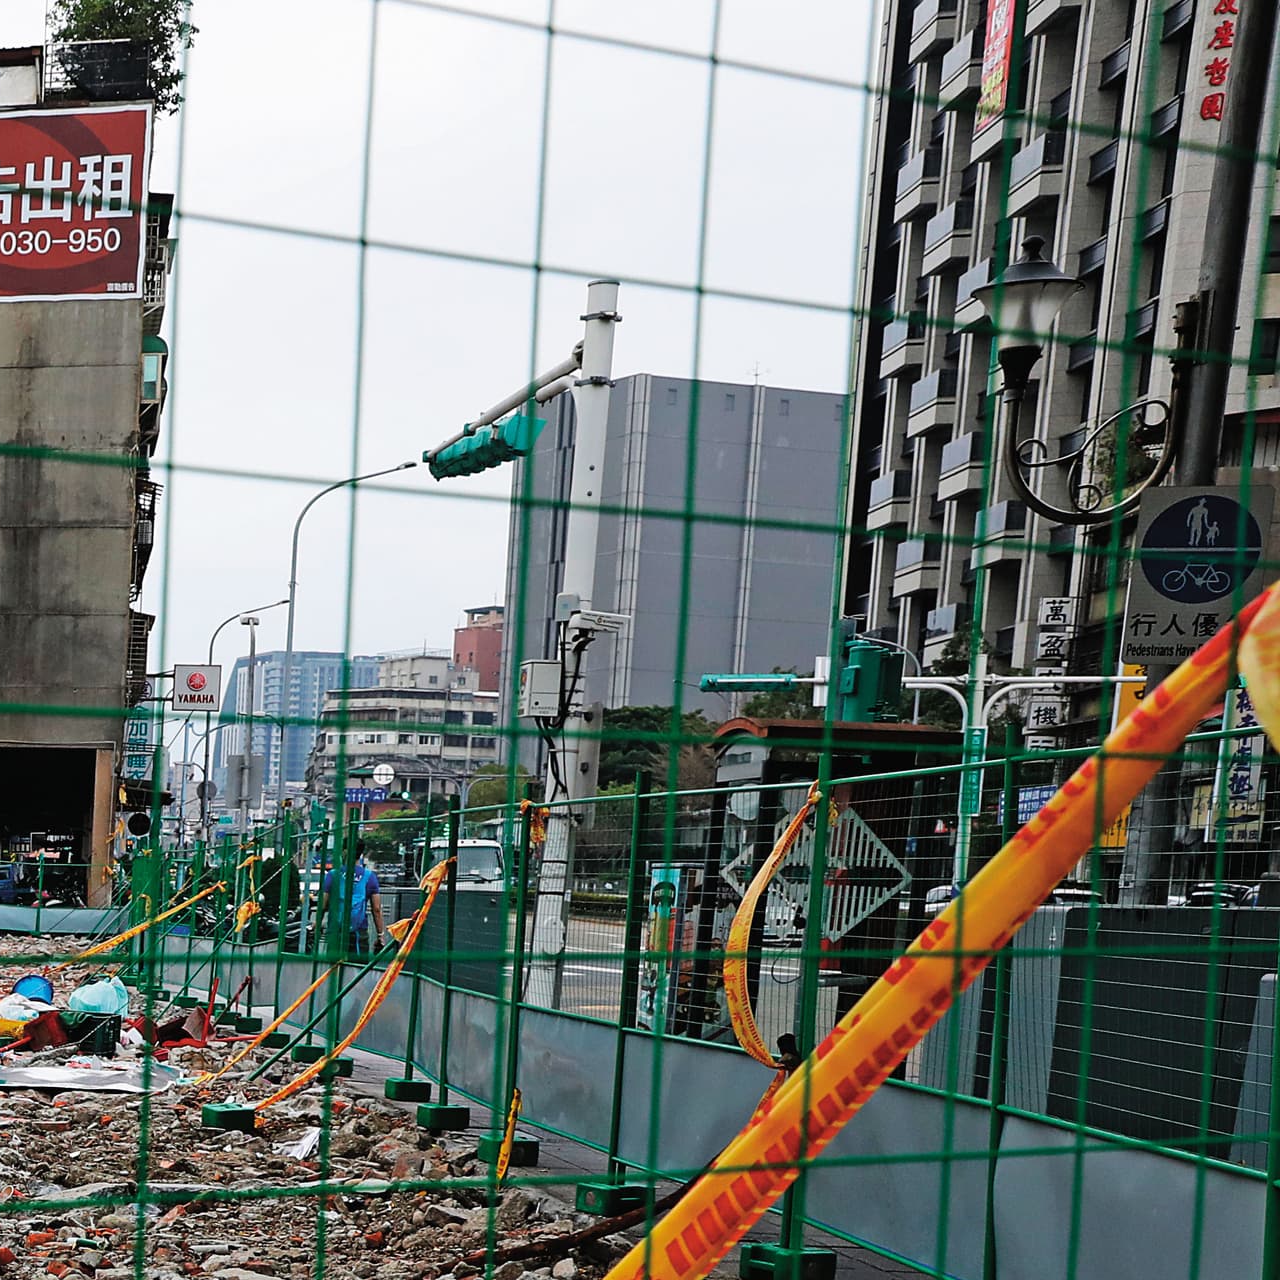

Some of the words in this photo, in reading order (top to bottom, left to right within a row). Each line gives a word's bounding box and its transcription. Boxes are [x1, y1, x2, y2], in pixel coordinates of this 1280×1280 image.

[1130, 613, 1234, 637] 行人優
[1126, 643, 1174, 657] Pedestrians
[178, 693, 214, 704] YAMAHA
